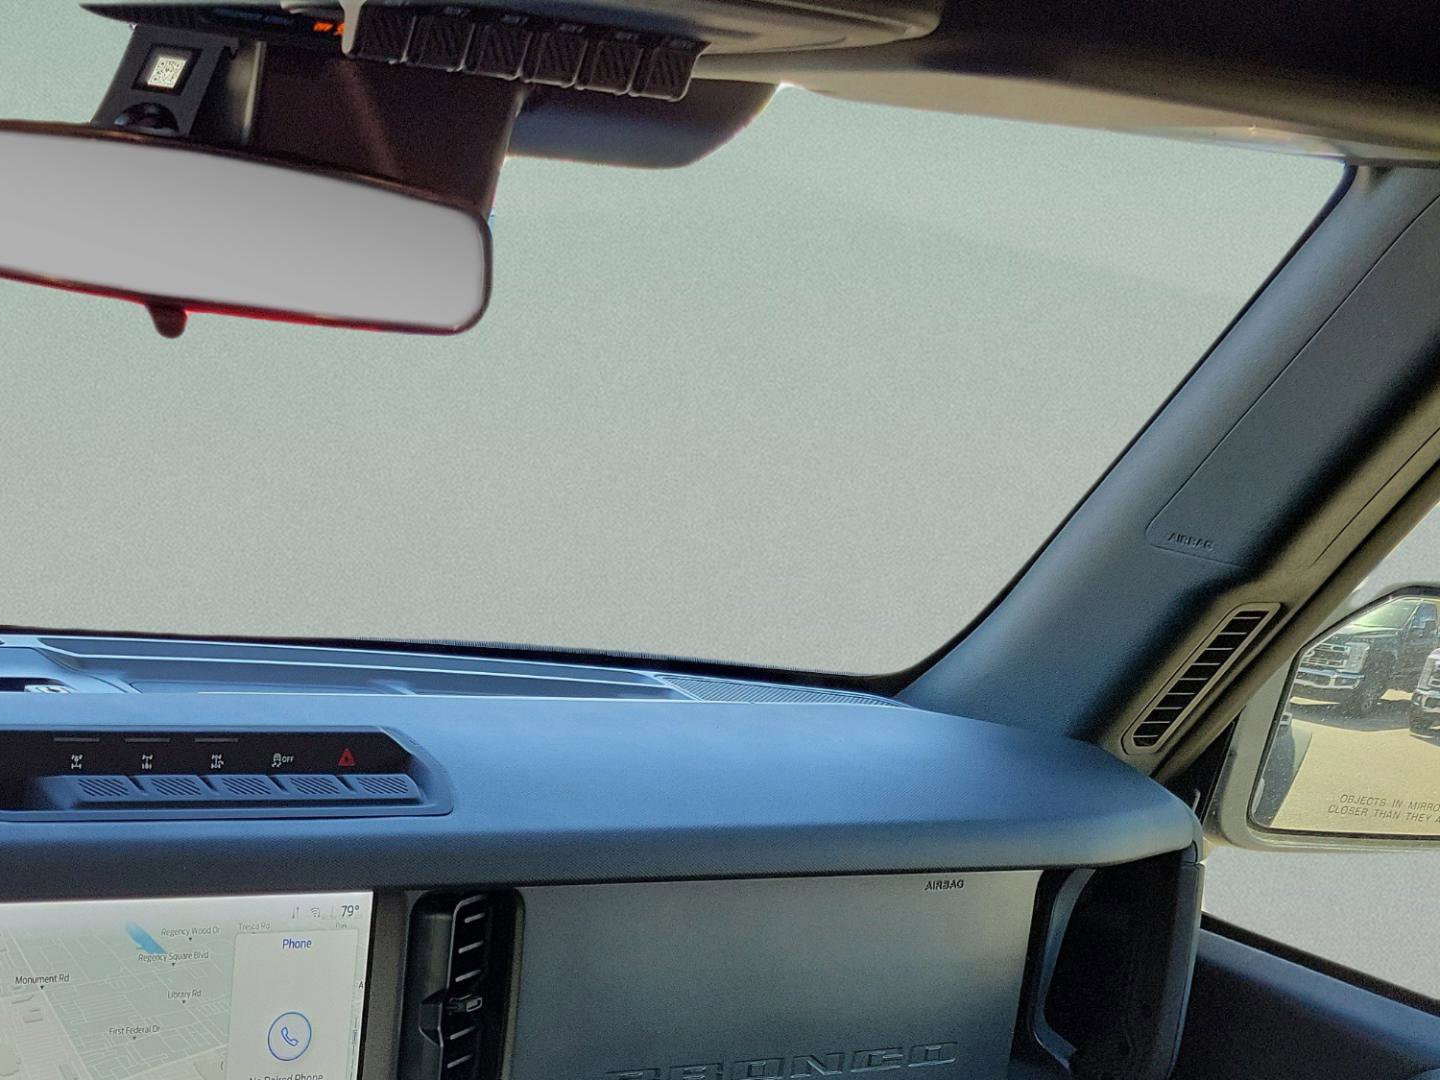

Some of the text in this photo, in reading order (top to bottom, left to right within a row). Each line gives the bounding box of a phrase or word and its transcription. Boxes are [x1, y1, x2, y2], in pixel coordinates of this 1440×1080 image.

[1340, 794, 1386, 807] OBJECTS
[1392, 800, 1403, 809] IN
[1328, 804, 1369, 817] CLOSER
[1374, 809, 1401, 820] THAN
[1406, 812, 1432, 822] THEY
[924, 879, 964, 891] AIRBAG
[161, 926, 220, 938] Regency Wood Dr
[282, 938, 312, 950] Phone
[138, 951, 209, 963] Regency Square Blvd
[15, 974, 70, 985] Monument Rd
[167, 989, 202, 1000] Library Rd
[109, 1027, 126, 1035] First
[126, 1025, 152, 1035] Federal
